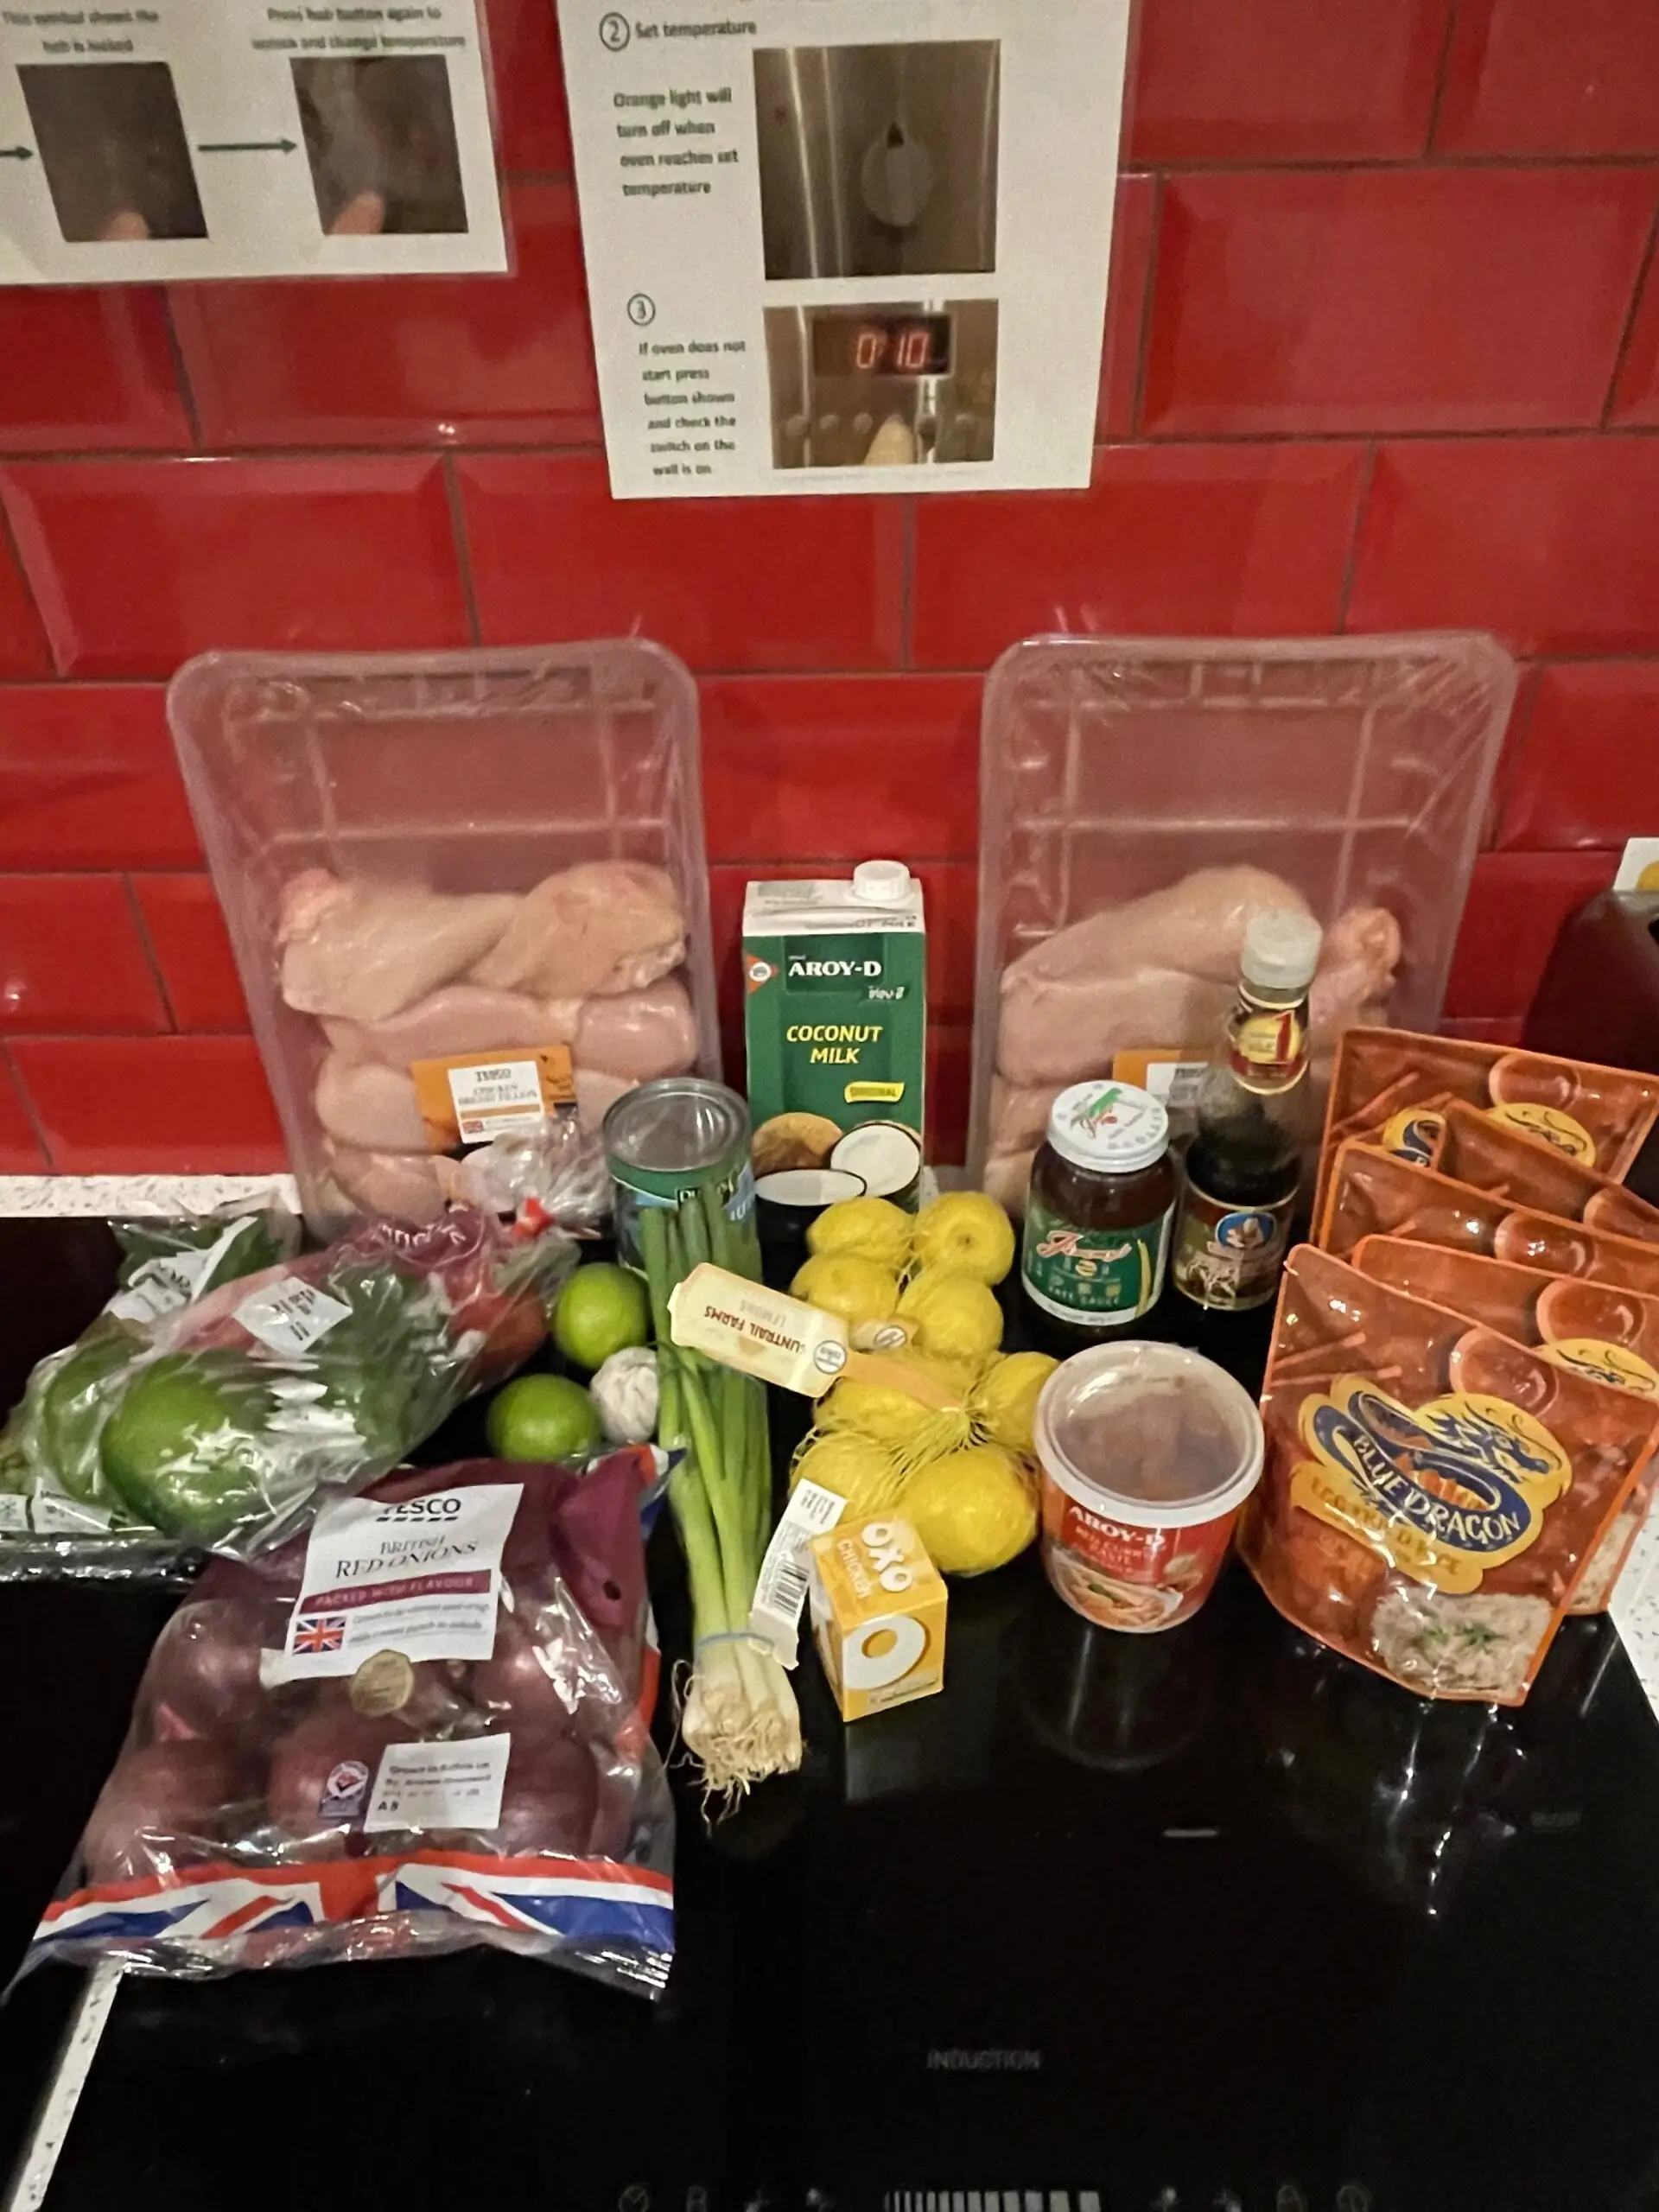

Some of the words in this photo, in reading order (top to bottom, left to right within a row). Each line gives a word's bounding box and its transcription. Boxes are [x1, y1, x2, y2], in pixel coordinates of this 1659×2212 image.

[636, 22, 659, 39] Set
[664, 20, 757, 39] temperature
[613, 92, 666, 110] Orange
[669, 88, 702, 109] light
[706, 86, 733, 104] will
[617, 124, 647, 138] turn
[652, 119, 671, 136] off
[675, 121, 715, 135] when
[620, 155, 655, 167] oven
[658, 149, 714, 166] reaches
[622, 181, 711, 198] temperature
[652, 344, 685, 355] oven
[688, 340, 720, 353] does
[723, 340, 746, 353] not
[642, 369, 671, 381] start
[676, 368, 710, 382] press
[644, 392, 689, 406] button
[692, 391, 735, 404] shown
[648, 417, 671, 429] and
[675, 416, 711, 429] check
[714, 416, 736, 428] the
[694, 442, 711, 452] on
[714, 439, 735, 451] the
[652, 464, 678, 475] wall
[695, 465, 712, 475] on
[788, 960, 882, 977] AROY-D
[785, 1025, 884, 1043] COCONUT
[809, 1047, 861, 1065] MILK
[703, 1305, 746, 1332] FARMS
[1353, 1434, 1409, 1500] BLUE
[1403, 1490, 1522, 1545] DRAGON
[335, 1557, 385, 1580] RED
[388, 1541, 479, 1569] ONIONS
[861, 1522, 913, 1592] OXO
